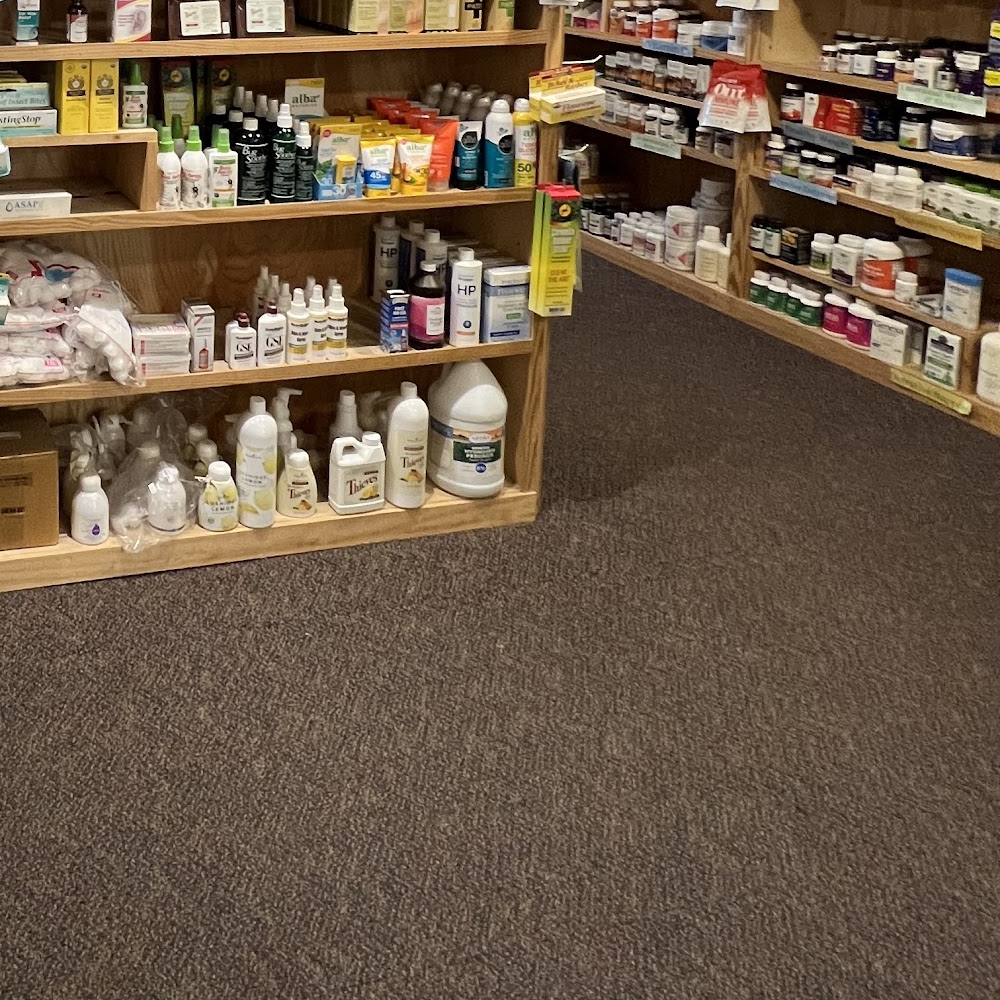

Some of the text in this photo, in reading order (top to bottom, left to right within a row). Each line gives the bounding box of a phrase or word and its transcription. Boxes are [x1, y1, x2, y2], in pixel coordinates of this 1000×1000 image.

[292, 94, 317, 104] alba
[518, 163, 532, 172] 50
[370, 171, 381, 179] 45
[333, 184, 347, 196] 30
[380, 247, 397, 258] HP
[457, 284, 476, 295] HP
[346, 475, 378, 495] Thieves
